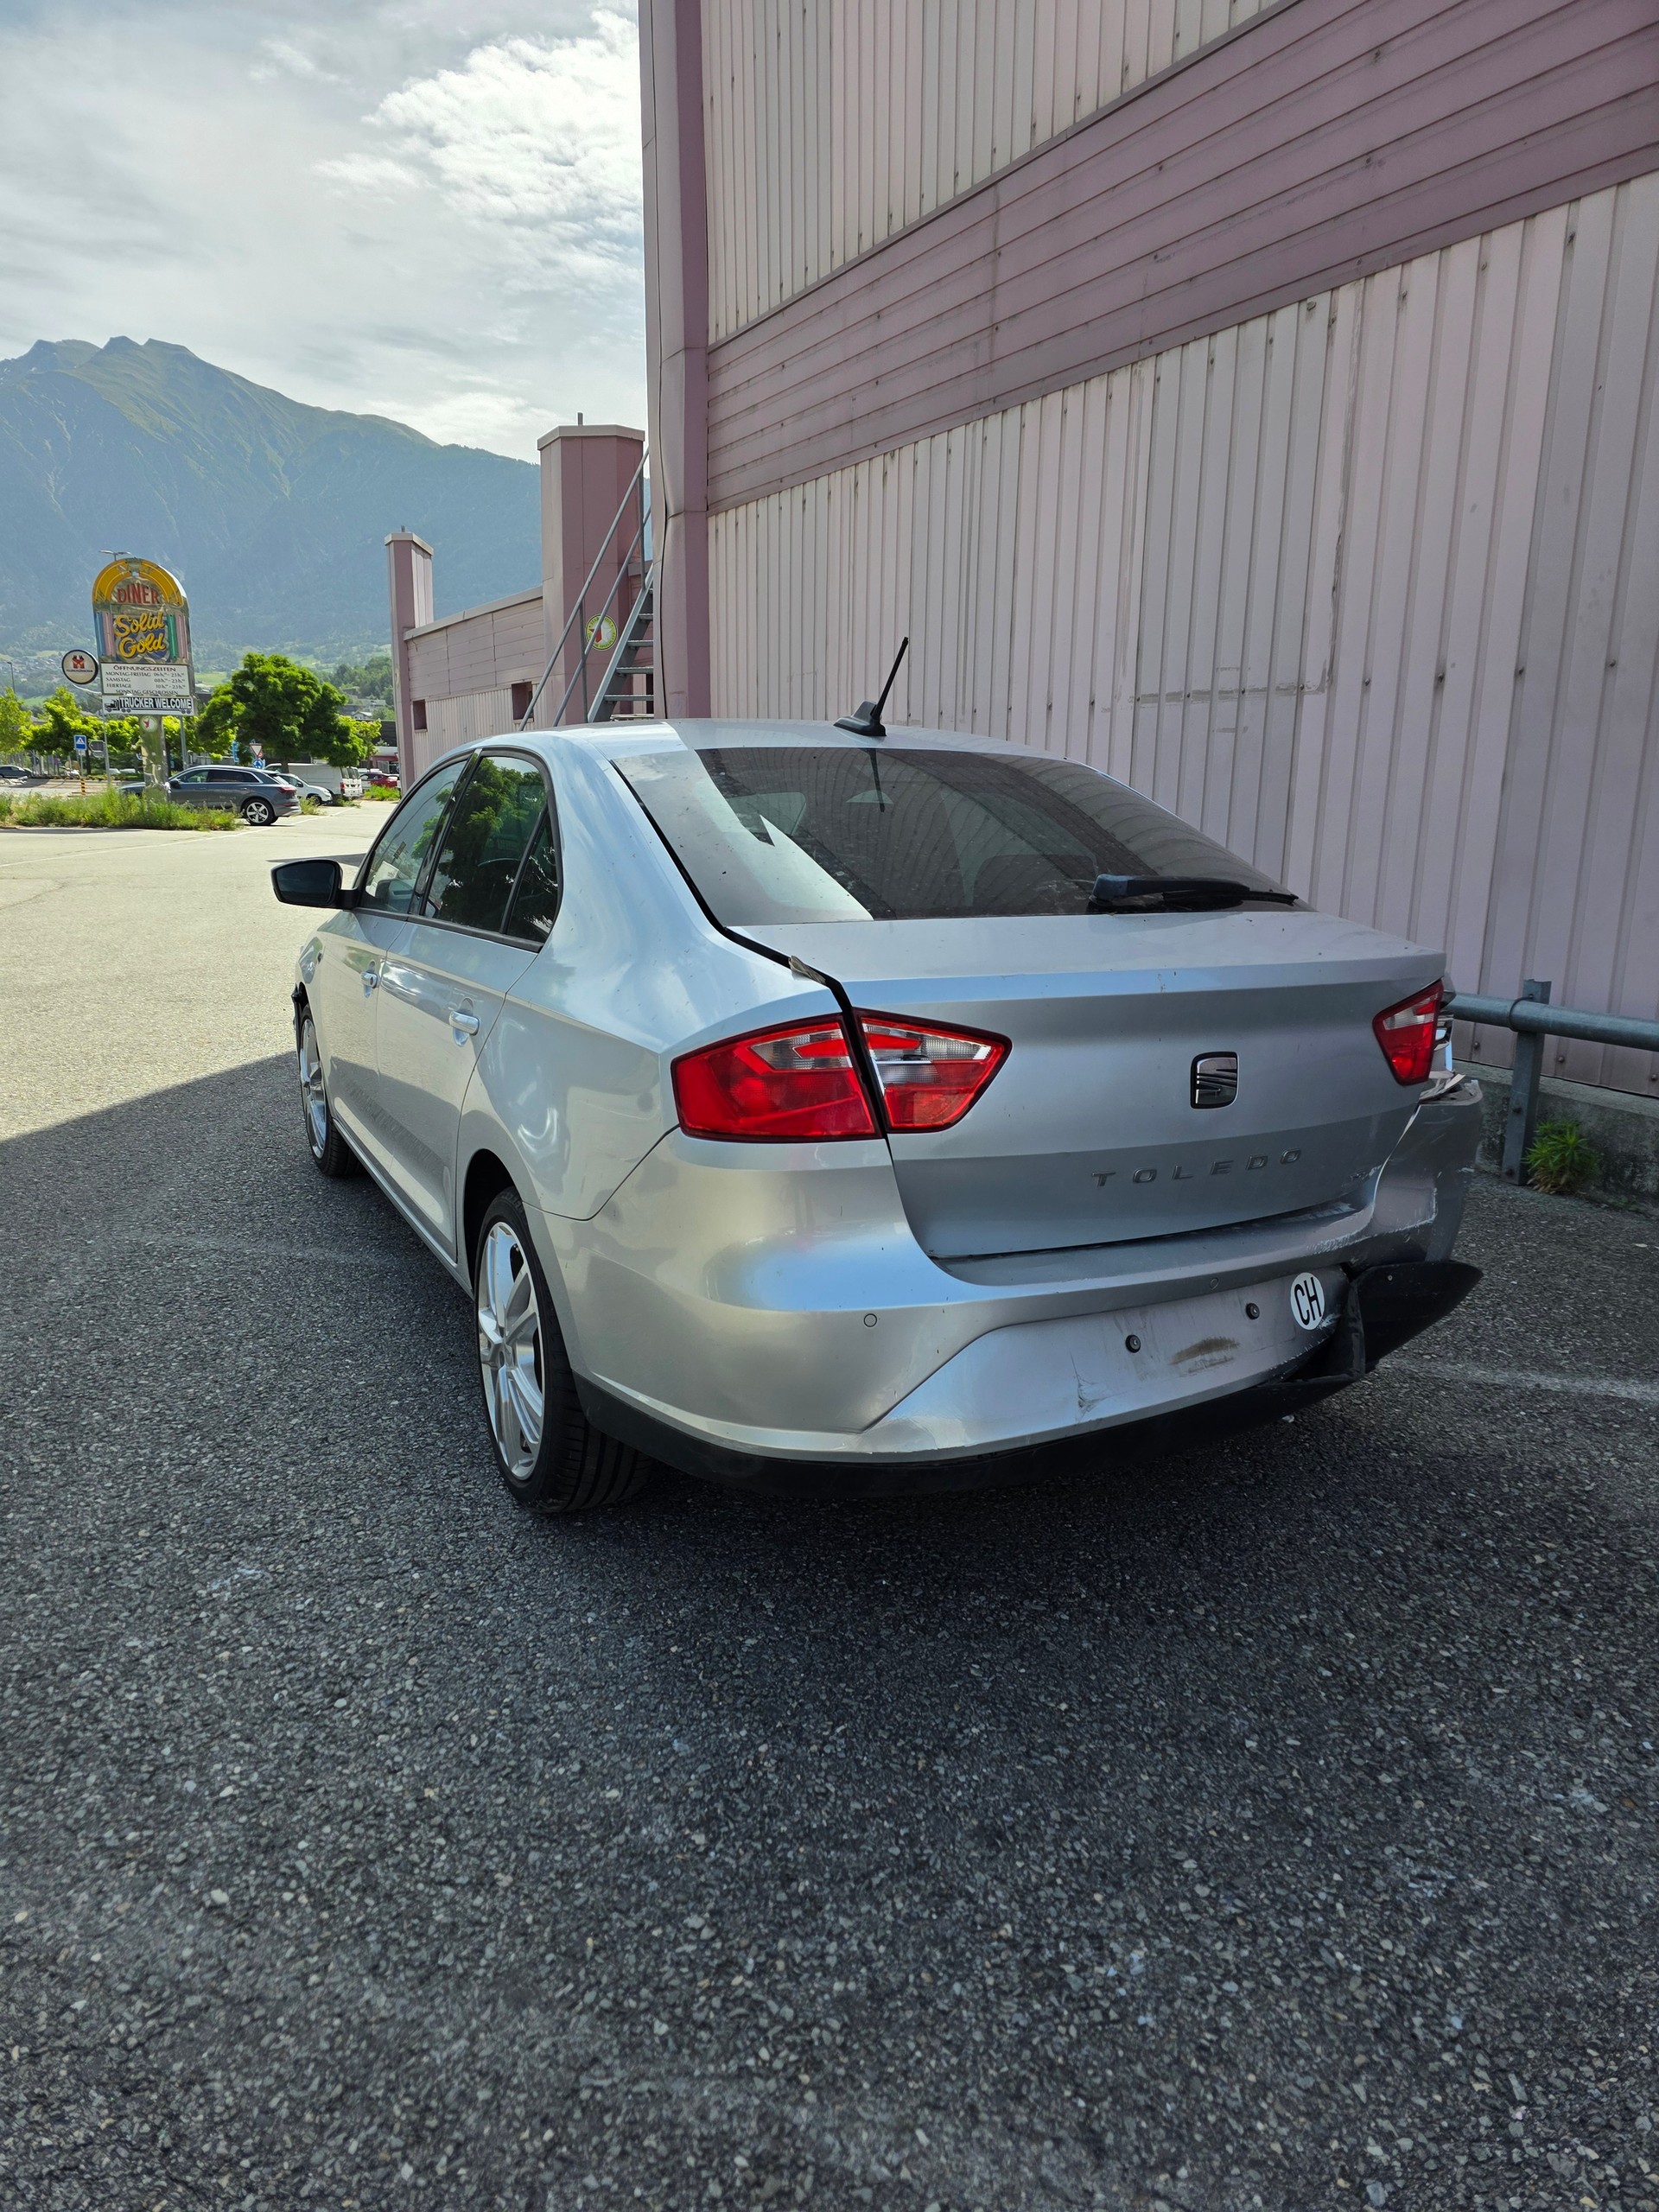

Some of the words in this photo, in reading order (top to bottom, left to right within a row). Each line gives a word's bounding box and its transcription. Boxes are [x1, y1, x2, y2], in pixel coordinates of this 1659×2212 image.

[117, 583, 160, 604] DINER
[114, 611, 166, 638] Solid
[119, 632, 165, 658] Gold
[119, 697, 154, 708] TRUCKER
[156, 698, 192, 709] WELCOME
[1091, 1147, 1301, 1187] TOLEDO
[1294, 1276, 1323, 1326] CH
